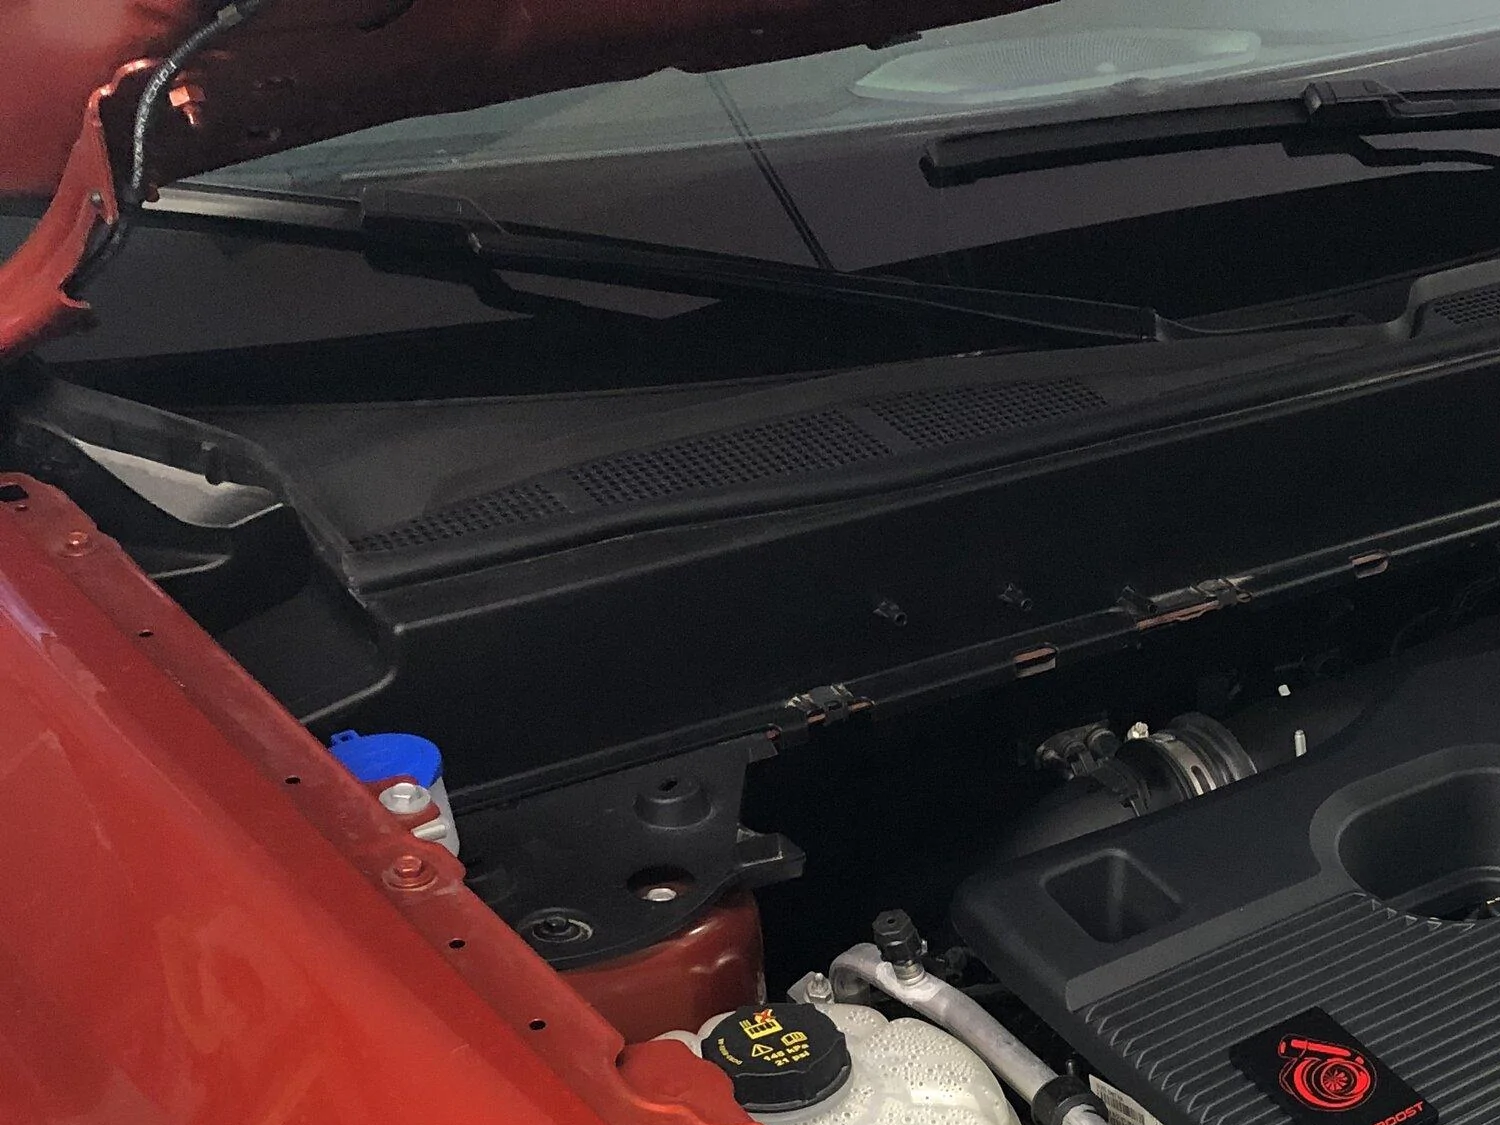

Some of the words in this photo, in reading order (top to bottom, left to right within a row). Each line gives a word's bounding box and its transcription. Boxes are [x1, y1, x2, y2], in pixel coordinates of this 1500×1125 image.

[786, 1043, 809, 1053] kPa
[774, 1057, 790, 1067] 21
[792, 1050, 810, 1061] psi
